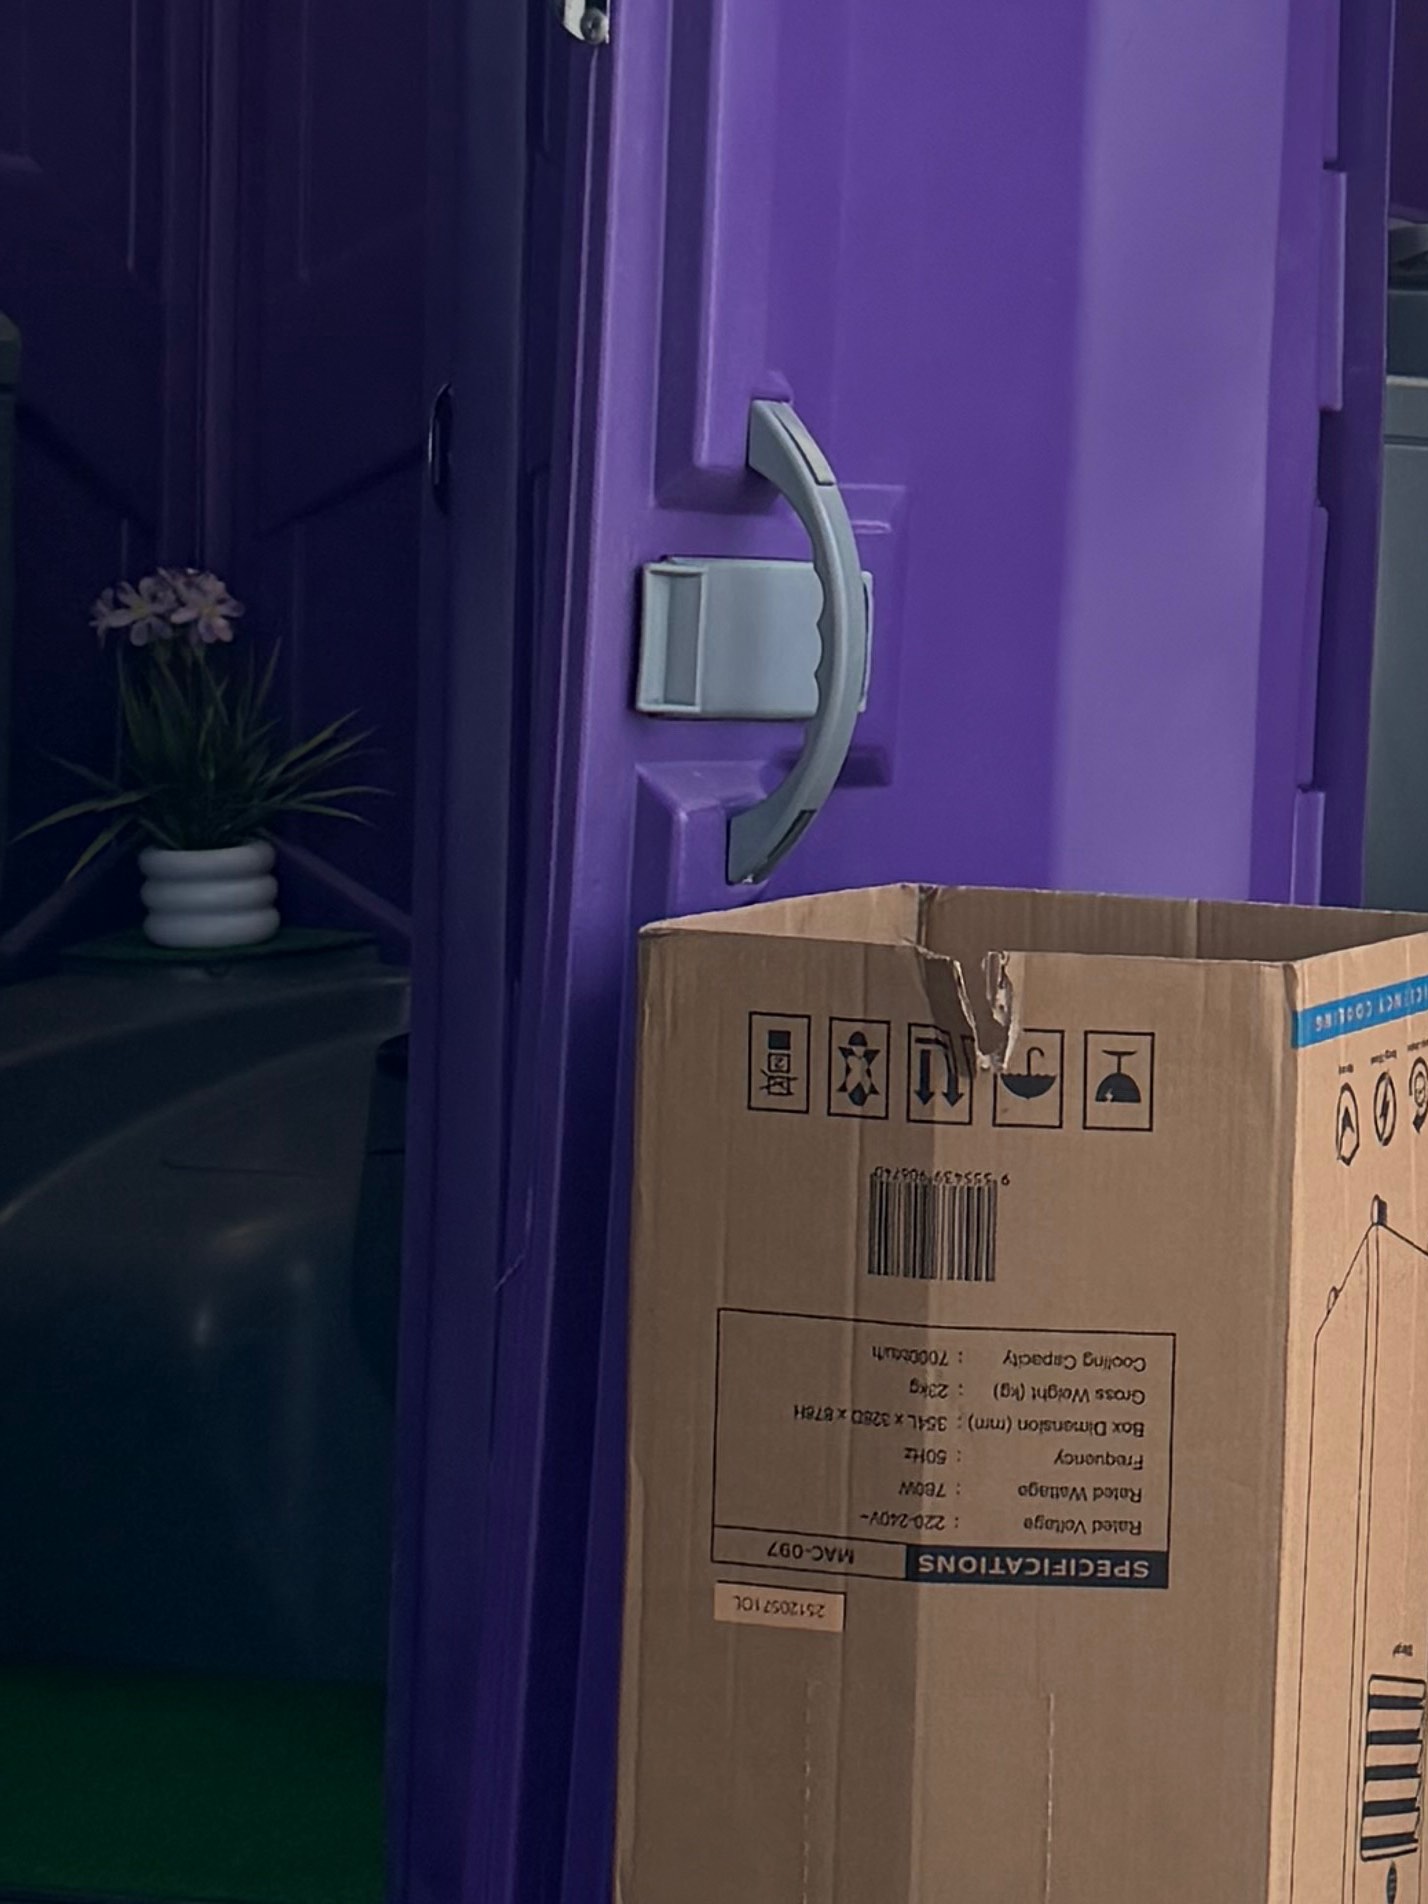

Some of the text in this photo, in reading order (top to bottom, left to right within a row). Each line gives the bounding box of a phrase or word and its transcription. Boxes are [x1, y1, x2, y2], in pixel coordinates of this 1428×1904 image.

[1003, 1350, 1076, 1370] Capacity
[1083, 1352, 1146, 1372] Cooling
[910, 1378, 948, 1399] 23kg
[994, 1383, 1025, 1401] (kg)
[1032, 1384, 1089, 1403] Weight
[1096, 1389, 1145, 1405] Gross
[968, 1414, 1012, 1433] (mm)
[1018, 1419, 1106, 1436] Dimension
[1113, 1422, 1144, 1437] Box
[905, 1448, 946, 1464] 50Hz
[1054, 1449, 1143, 1470] Frequency
[899, 1482, 946, 1497] 780W
[1018, 1482, 1087, 1501] Wattage
[1093, 1485, 1141, 1503] Rated
[1024, 1515, 1086, 1534] Voltage
[1092, 1518, 1141, 1535] Rated
[766, 1541, 855, 1565] MAC-097
[920, 1555, 1147, 1577] SPECIFICATIONS
